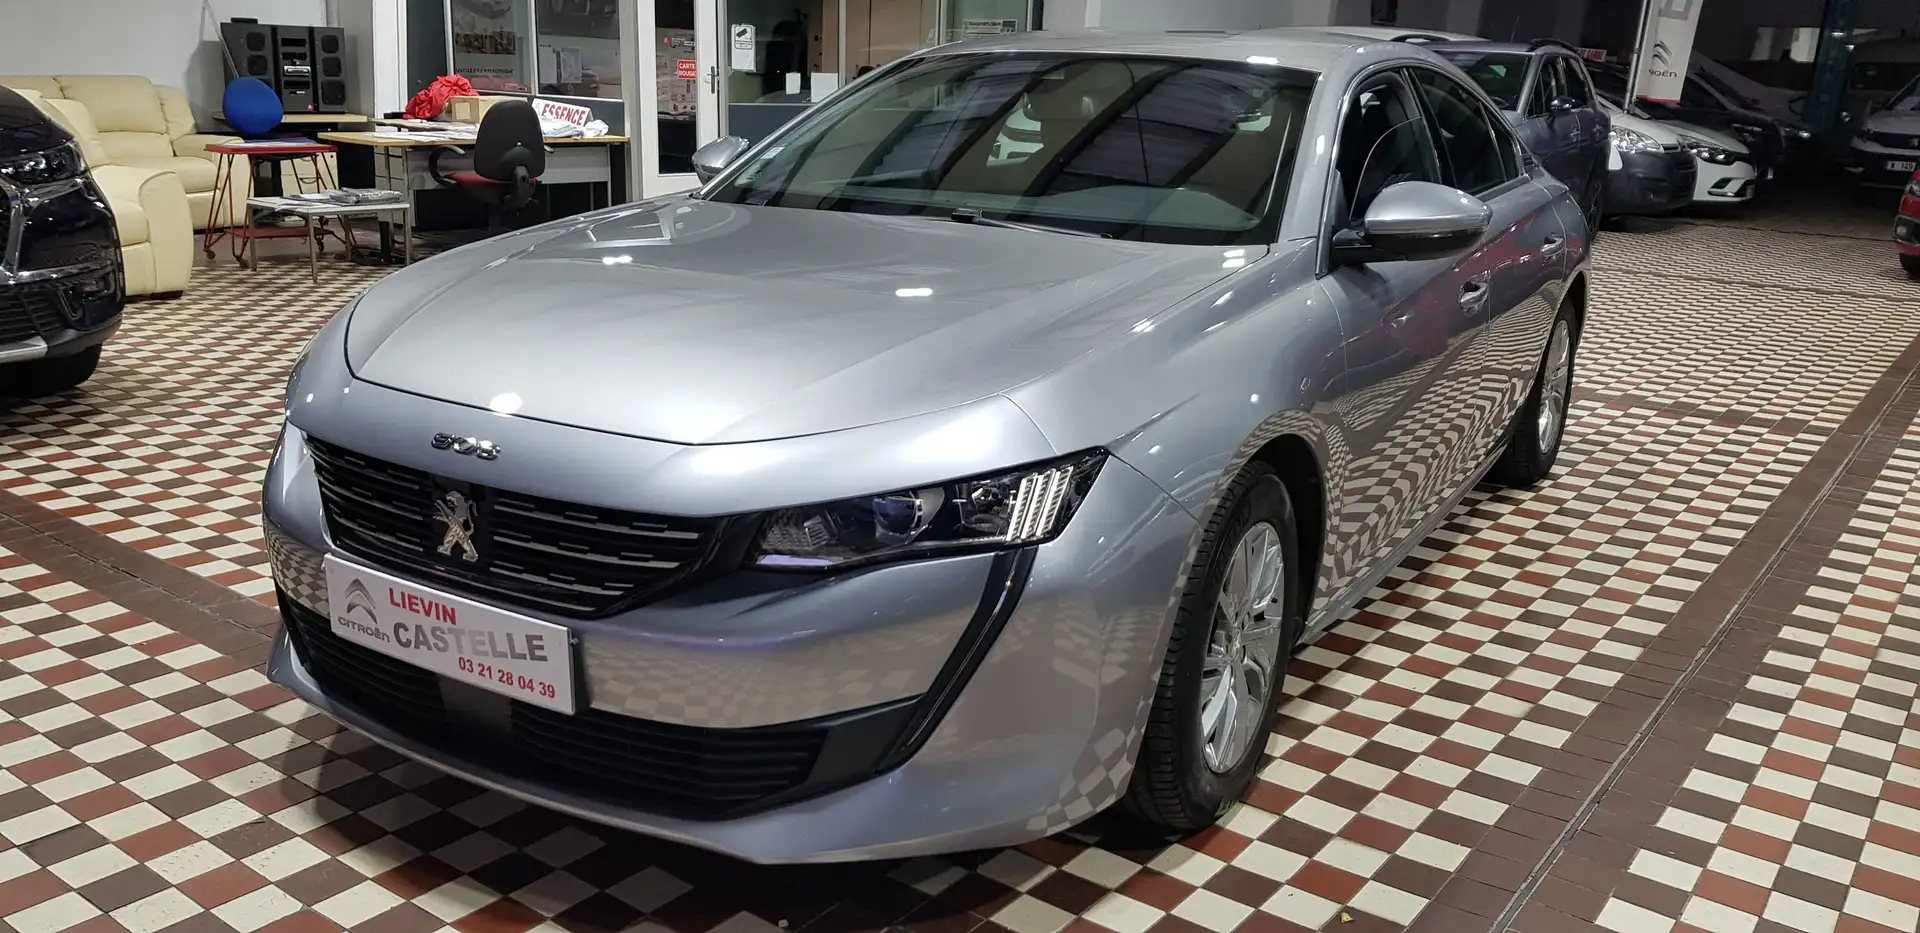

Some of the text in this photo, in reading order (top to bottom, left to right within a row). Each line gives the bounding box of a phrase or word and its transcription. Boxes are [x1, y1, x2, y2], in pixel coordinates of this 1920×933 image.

[541, 103, 585, 125] ESSENCE
[431, 432, 501, 460] 508
[388, 587, 456, 625] LIEVIN
[393, 621, 548, 662] CASTELLE
[458, 656, 556, 699] 03 21 28 04 39
